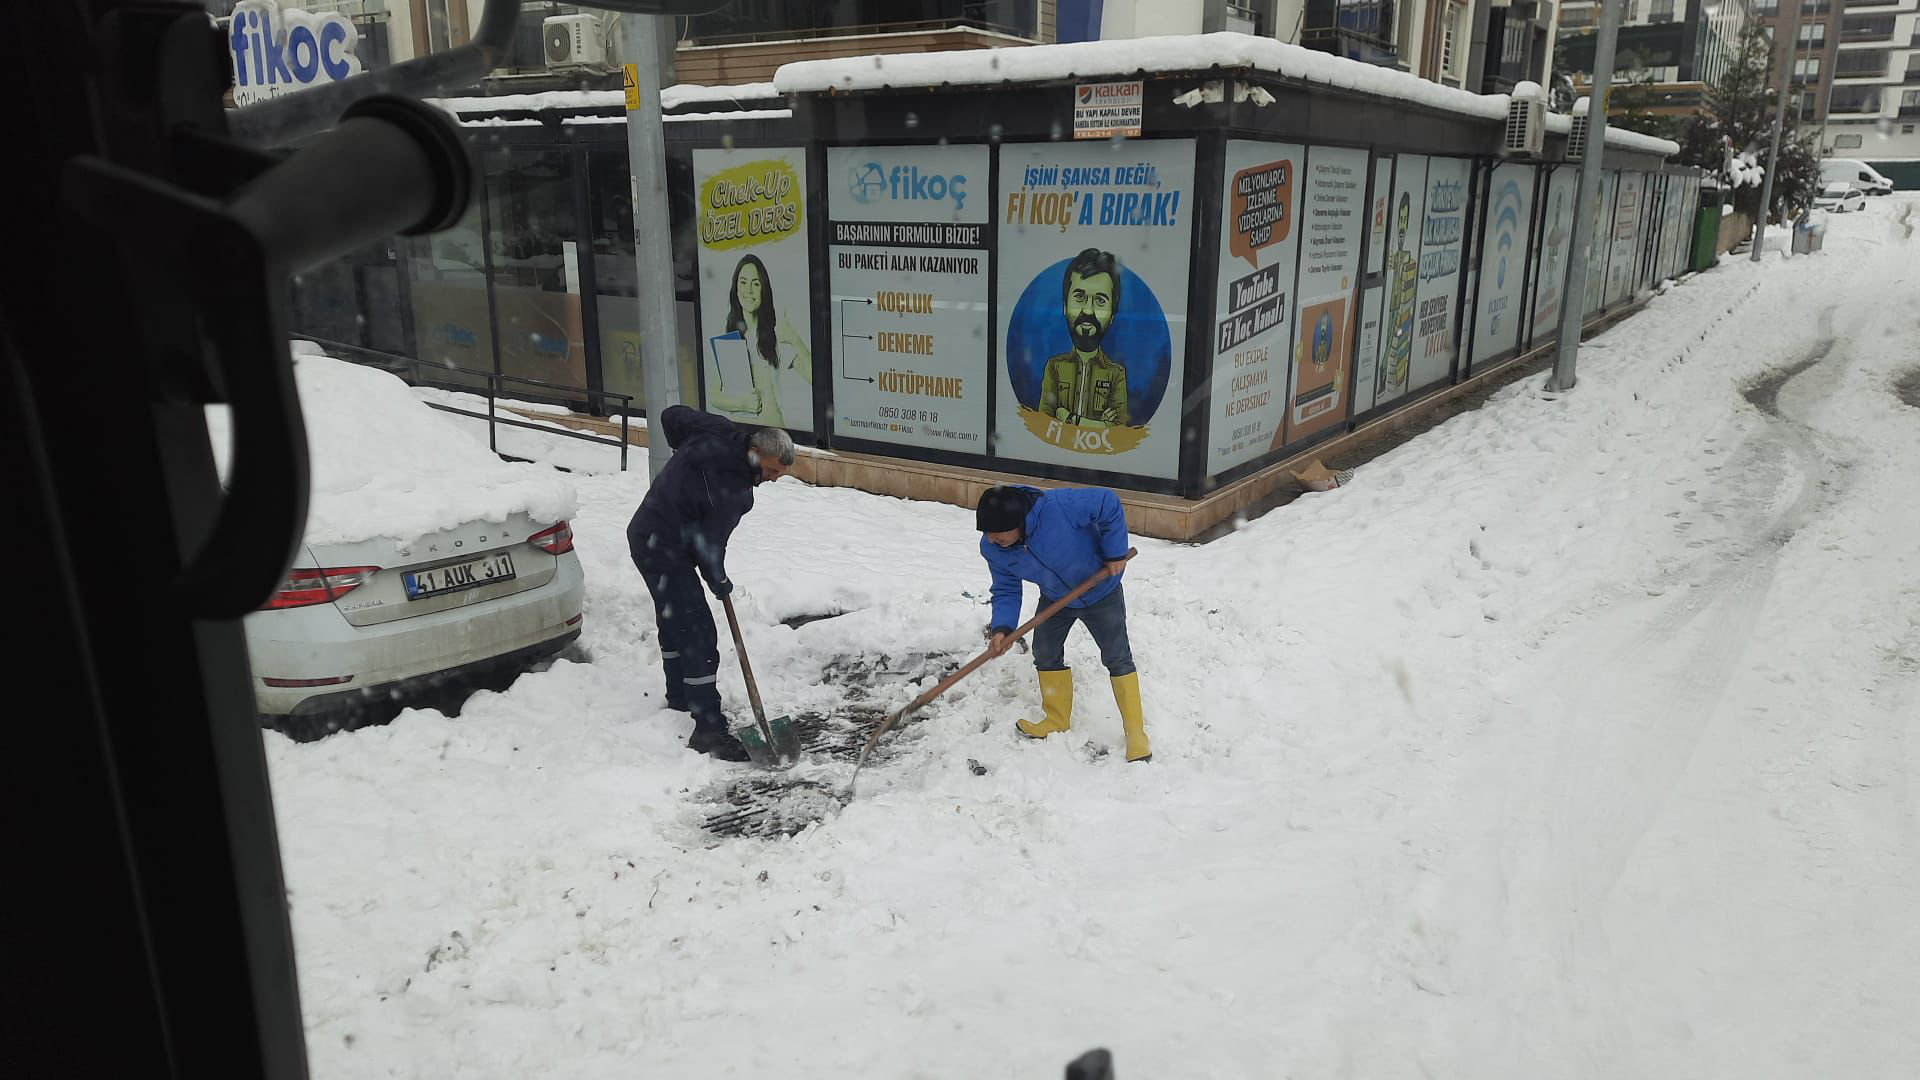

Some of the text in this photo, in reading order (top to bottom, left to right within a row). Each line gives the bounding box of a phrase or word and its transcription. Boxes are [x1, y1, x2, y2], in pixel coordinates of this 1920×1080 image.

[1076, 107, 1141, 118] BU YAPI KAPALI DEVRE
[711, 168, 791, 209] Chek-Up
[890, 166, 967, 210] fikoç
[1024, 164, 1059, 191] İŞİNİ
[1061, 167, 1110, 191] ŞANSA
[1239, 168, 1286, 195] MİLYONLARCA
[703, 203, 796, 243] ÖZEL DERS
[1006, 186, 1180, 233] Fİ KOÇ'A BIRAK!
[837, 223, 980, 245] BAŞARININ FORMÜLÜ BİZDE!
[839, 251, 978, 275] BU PAKETİ ALAN KAZANIYOR
[1236, 271, 1274, 309] YouTube
[877, 291, 933, 318] KOÇLUK
[1221, 296, 1283, 350] Fi Koç Kanalı
[878, 332, 934, 356] DENEME
[1234, 351, 1245, 368] BU
[878, 368, 963, 399] KÜTÜPHANE
[1231, 368, 1268, 397] ÇALIŞMAYA
[879, 406, 938, 423] 0850 308 16 18
[1224, 402, 1235, 418] NE
[1074, 427, 1114, 453] KOÇ
[417, 572, 436, 592] 41
[444, 564, 477, 588] AUK
[482, 556, 510, 578] 311
